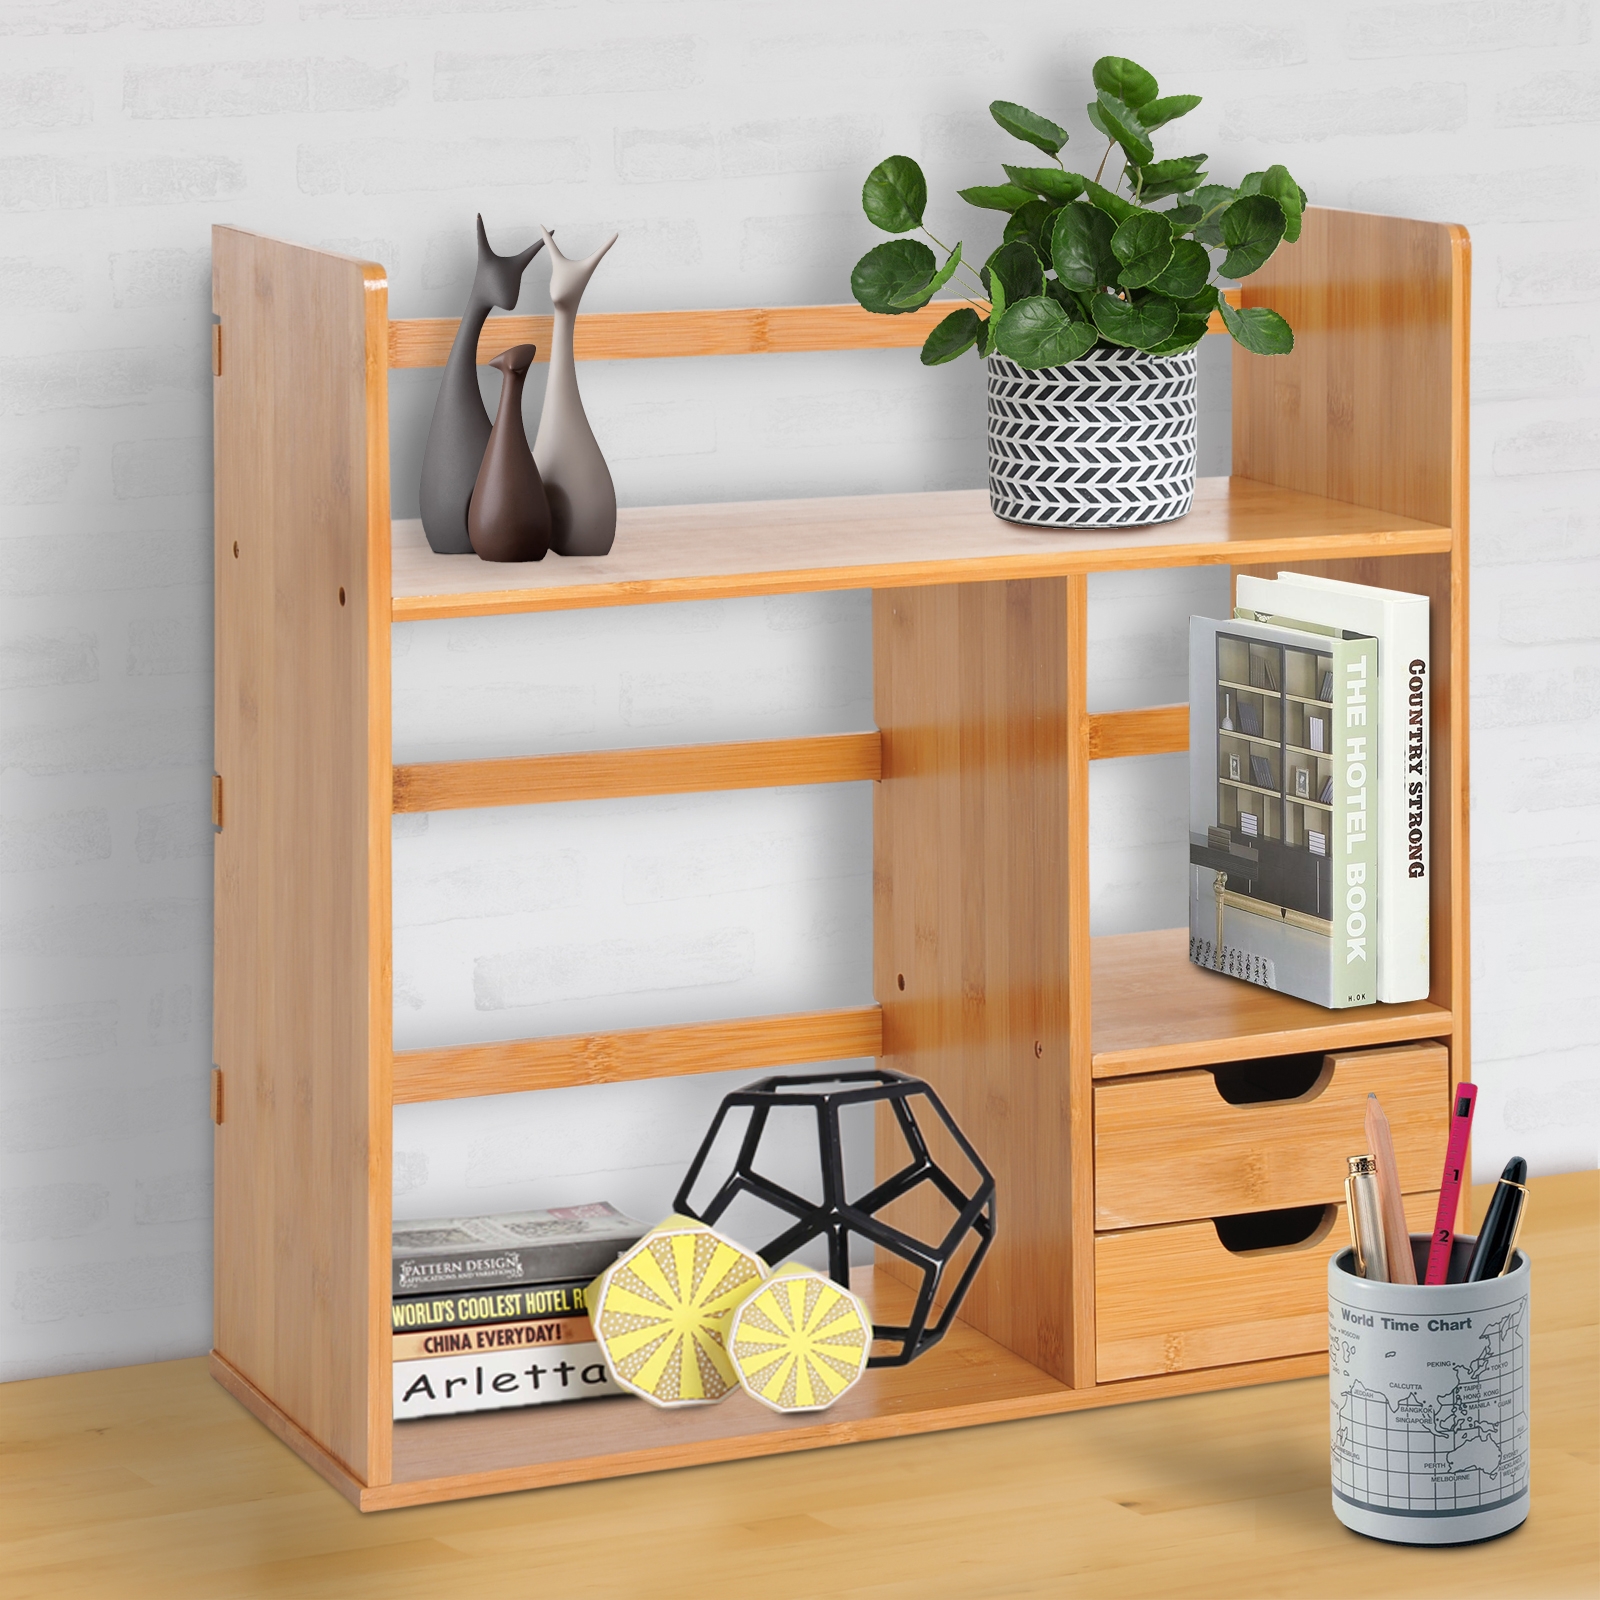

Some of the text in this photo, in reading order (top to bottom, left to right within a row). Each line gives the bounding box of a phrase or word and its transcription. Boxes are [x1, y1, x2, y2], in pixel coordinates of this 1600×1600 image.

[1408, 658, 1426, 879] COUNTRY STRONG
[1346, 655, 1367, 965] THE HOTEL BOOK
[1453, 1169, 1459, 1181] 1
[1439, 1229, 1450, 1243] 2
[405, 1258, 516, 1276] PATTERN DESIGN
[393, 1299, 455, 1327] WORLD'S
[458, 1293, 521, 1321] COOLEST
[525, 1289, 571, 1315] HOTEL
[1341, 1307, 1374, 1328] World
[1381, 1317, 1419, 1332] Time
[1427, 1317, 1472, 1332] Chart
[424, 1323, 562, 1354] CHINA EVERYDAY!
[1427, 1360, 1451, 1368] PEKING
[1491, 1361, 1508, 1371] TOKYO
[402, 1361, 608, 1403] Arletta
[1389, 1382, 1422, 1390] CALCUTTA
[1463, 1384, 1482, 1392] TAIPEI
[1463, 1388, 1499, 1401] HONG KONG
[1400, 1406, 1433, 1414] BANGKOK
[1469, 1402, 1490, 1411] MANILA
[1395, 1417, 1433, 1425] SINGAPORE
[1431, 1474, 1470, 1483] MELBOURNE
